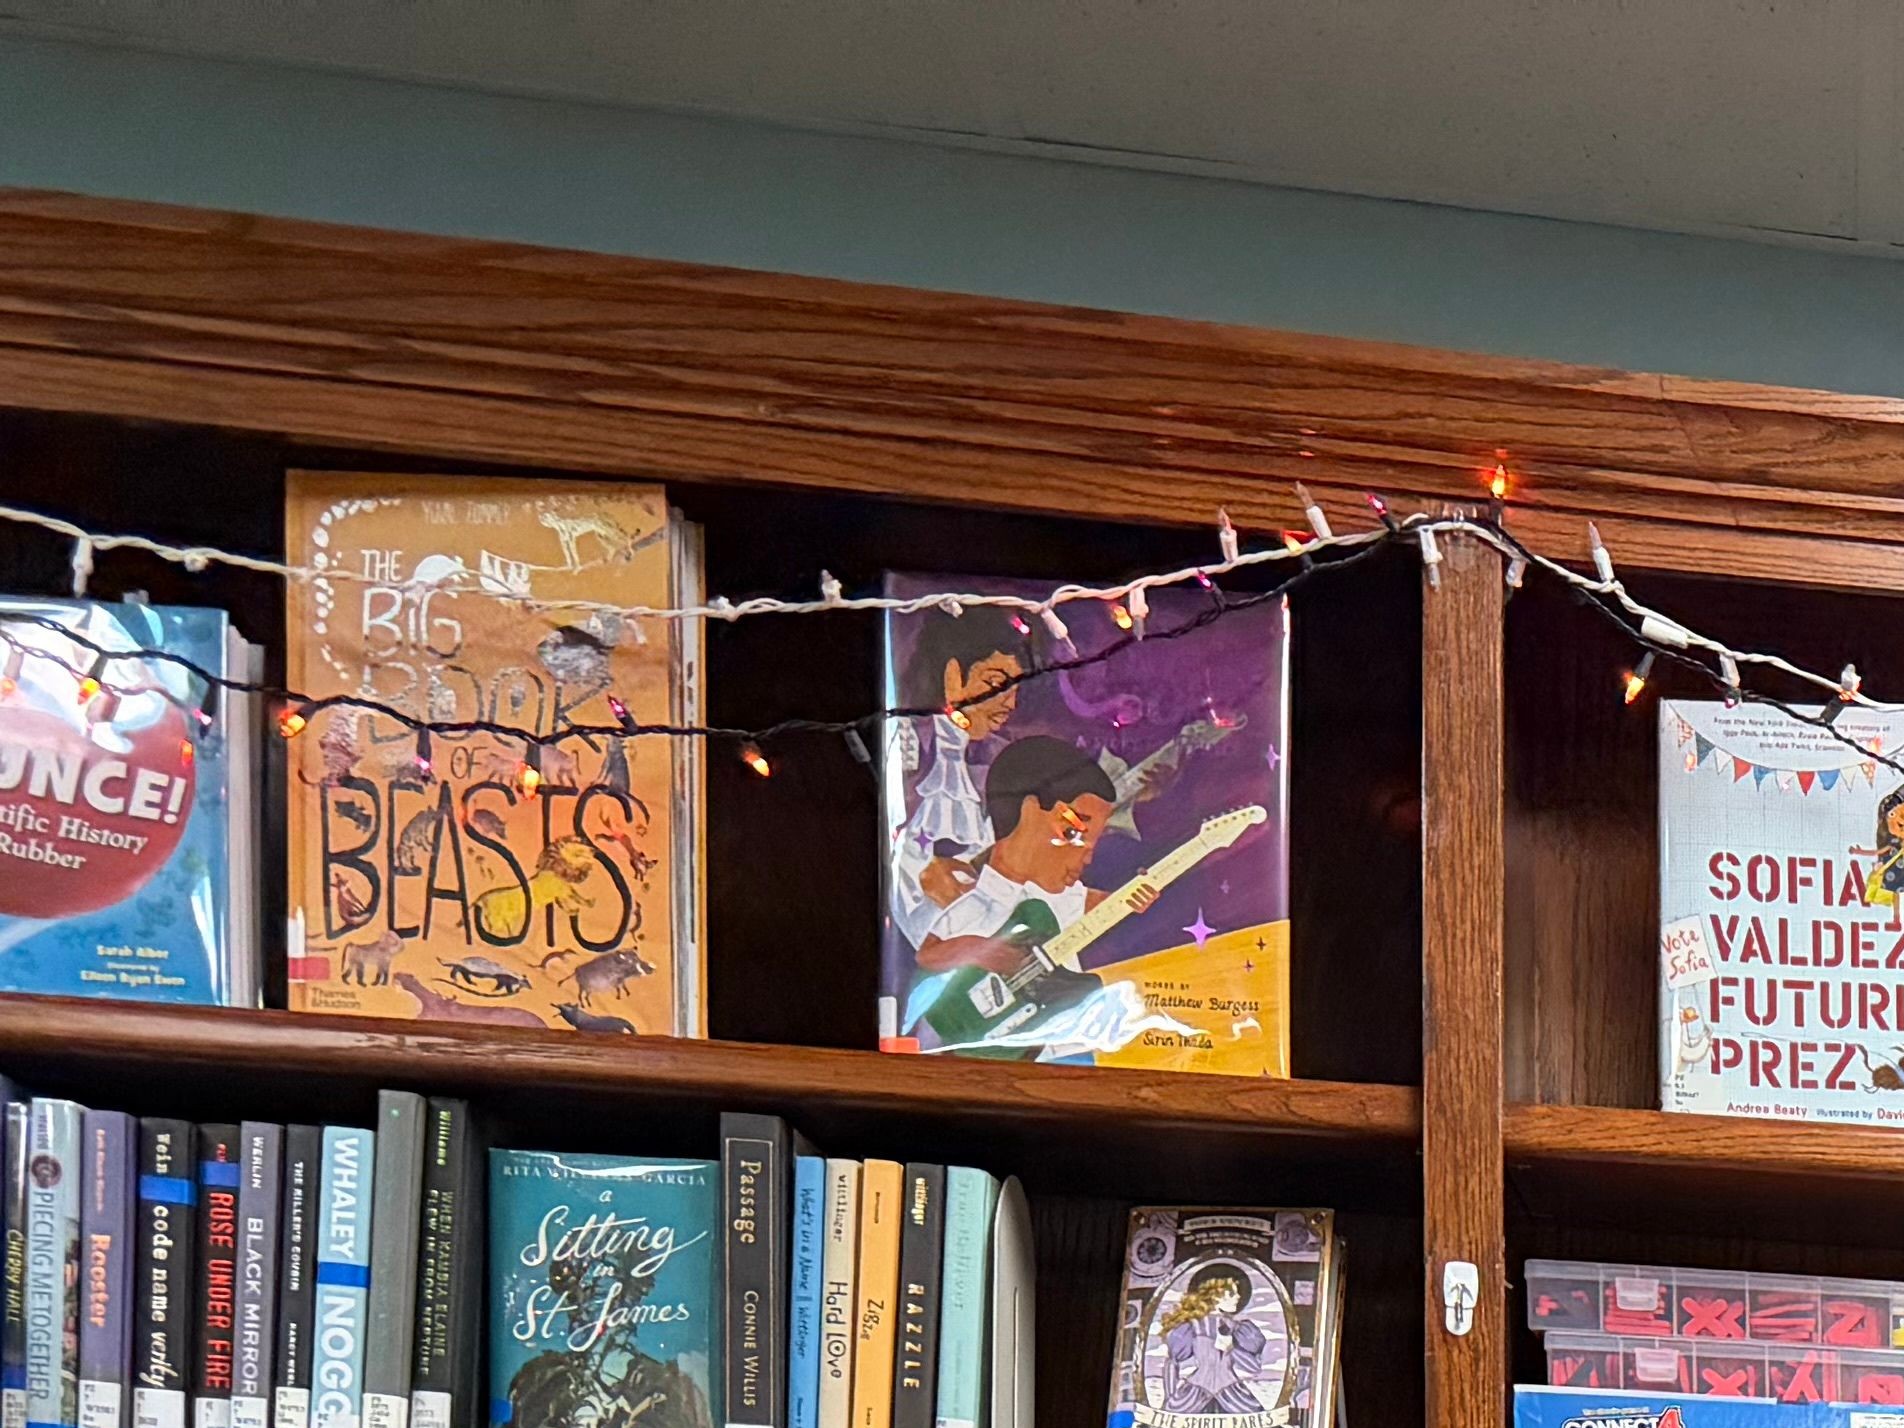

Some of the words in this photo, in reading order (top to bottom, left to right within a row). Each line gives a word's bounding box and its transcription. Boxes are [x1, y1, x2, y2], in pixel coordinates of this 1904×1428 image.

[360, 548, 402, 582] THE
[362, 584, 461, 659] BIG
[361, 661, 605, 752] BOOK
[451, 746, 486, 779] OF
[0, 832, 87, 869] Rubber
[58, 816, 148, 854] History
[320, 780, 634, 951] BEASTS
[1708, 852, 1871, 908] SOFIA
[1662, 931, 1700, 955] Vote
[1670, 953, 1710, 981] Sofia
[1711, 1039, 1857, 1092] PREZ
[1727, 1102, 1770, 1116] Andrea
[1774, 1104, 1807, 1119] Beaty
[209, 1192, 235, 1247] ROSE
[329, 1137, 359, 1260] WHALEY
[732, 1158, 762, 1245] Passage
[152, 1206, 169, 1252] code
[246, 1217, 264, 1288] BLACK
[520, 1204, 709, 1279] Sitting
[151, 1268, 169, 1323] name
[206, 1260, 234, 1329] UNDER
[567, 1283, 690, 1352] James
[742, 1290, 760, 1353] CONNIE
[241, 1296, 262, 1395] MIRROR
[901, 1282, 925, 1390] RAZZLE
[204, 1340, 231, 1390] FIRE
[742, 1358, 760, 1408] WILLIS
